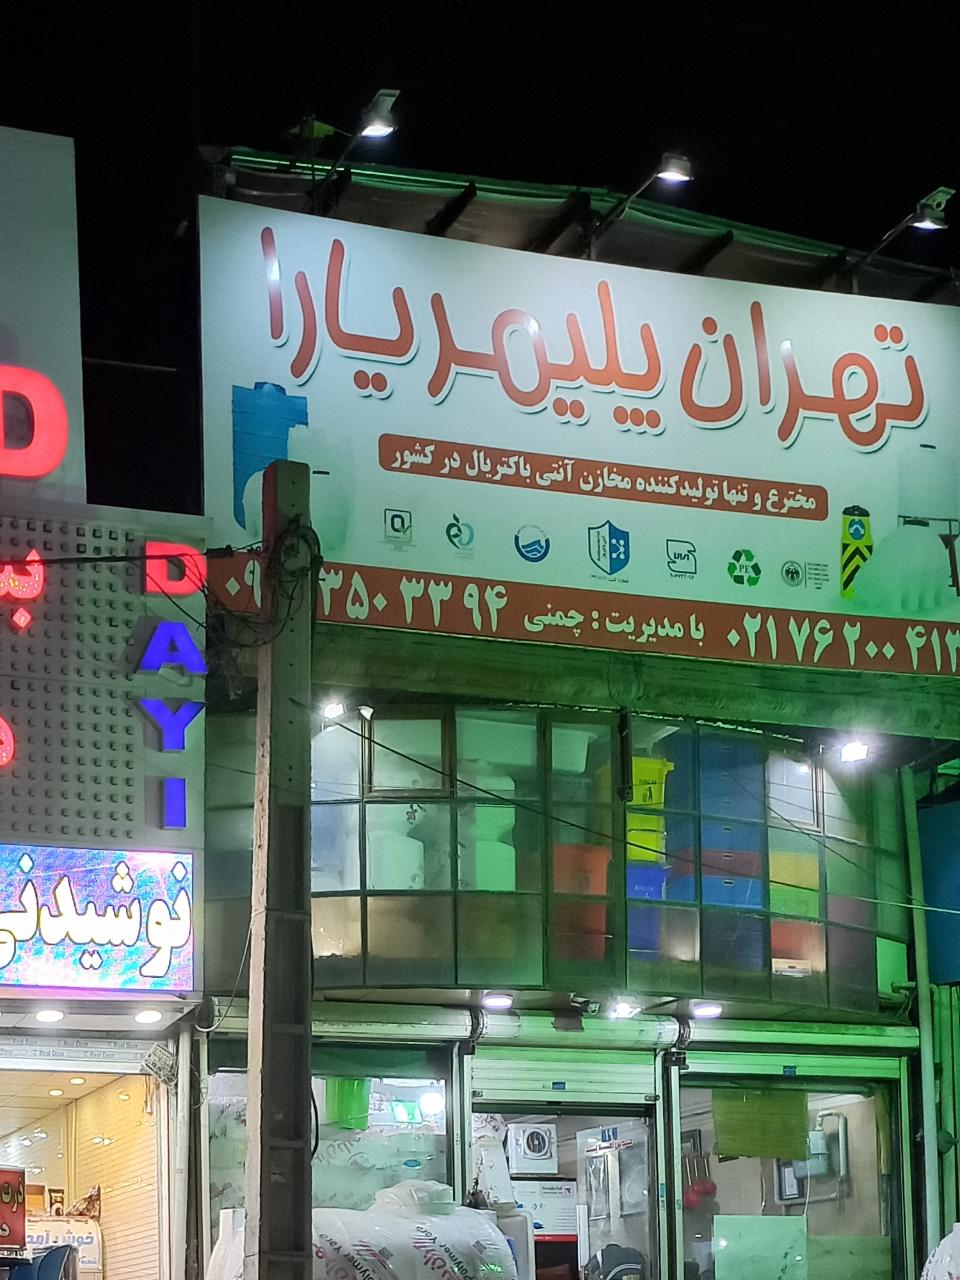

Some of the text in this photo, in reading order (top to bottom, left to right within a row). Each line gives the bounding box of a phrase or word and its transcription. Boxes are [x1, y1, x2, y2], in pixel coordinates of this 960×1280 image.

[260, 227, 928, 450] تهران پلیمر یارا
[390, 442, 436, 469] کشور
[440, 450, 461, 474] در
[465, 449, 531, 483] باکتریال
[535, 459, 575, 487] آنتی
[579, 467, 632, 494] مخازن
[722, 481, 749, 506] تنها
[752, 492, 762, 511] و
[766, 489, 817, 513] مخترع
[524, 603, 584, 637] چمنی
[689, 613, 705, 647] با
